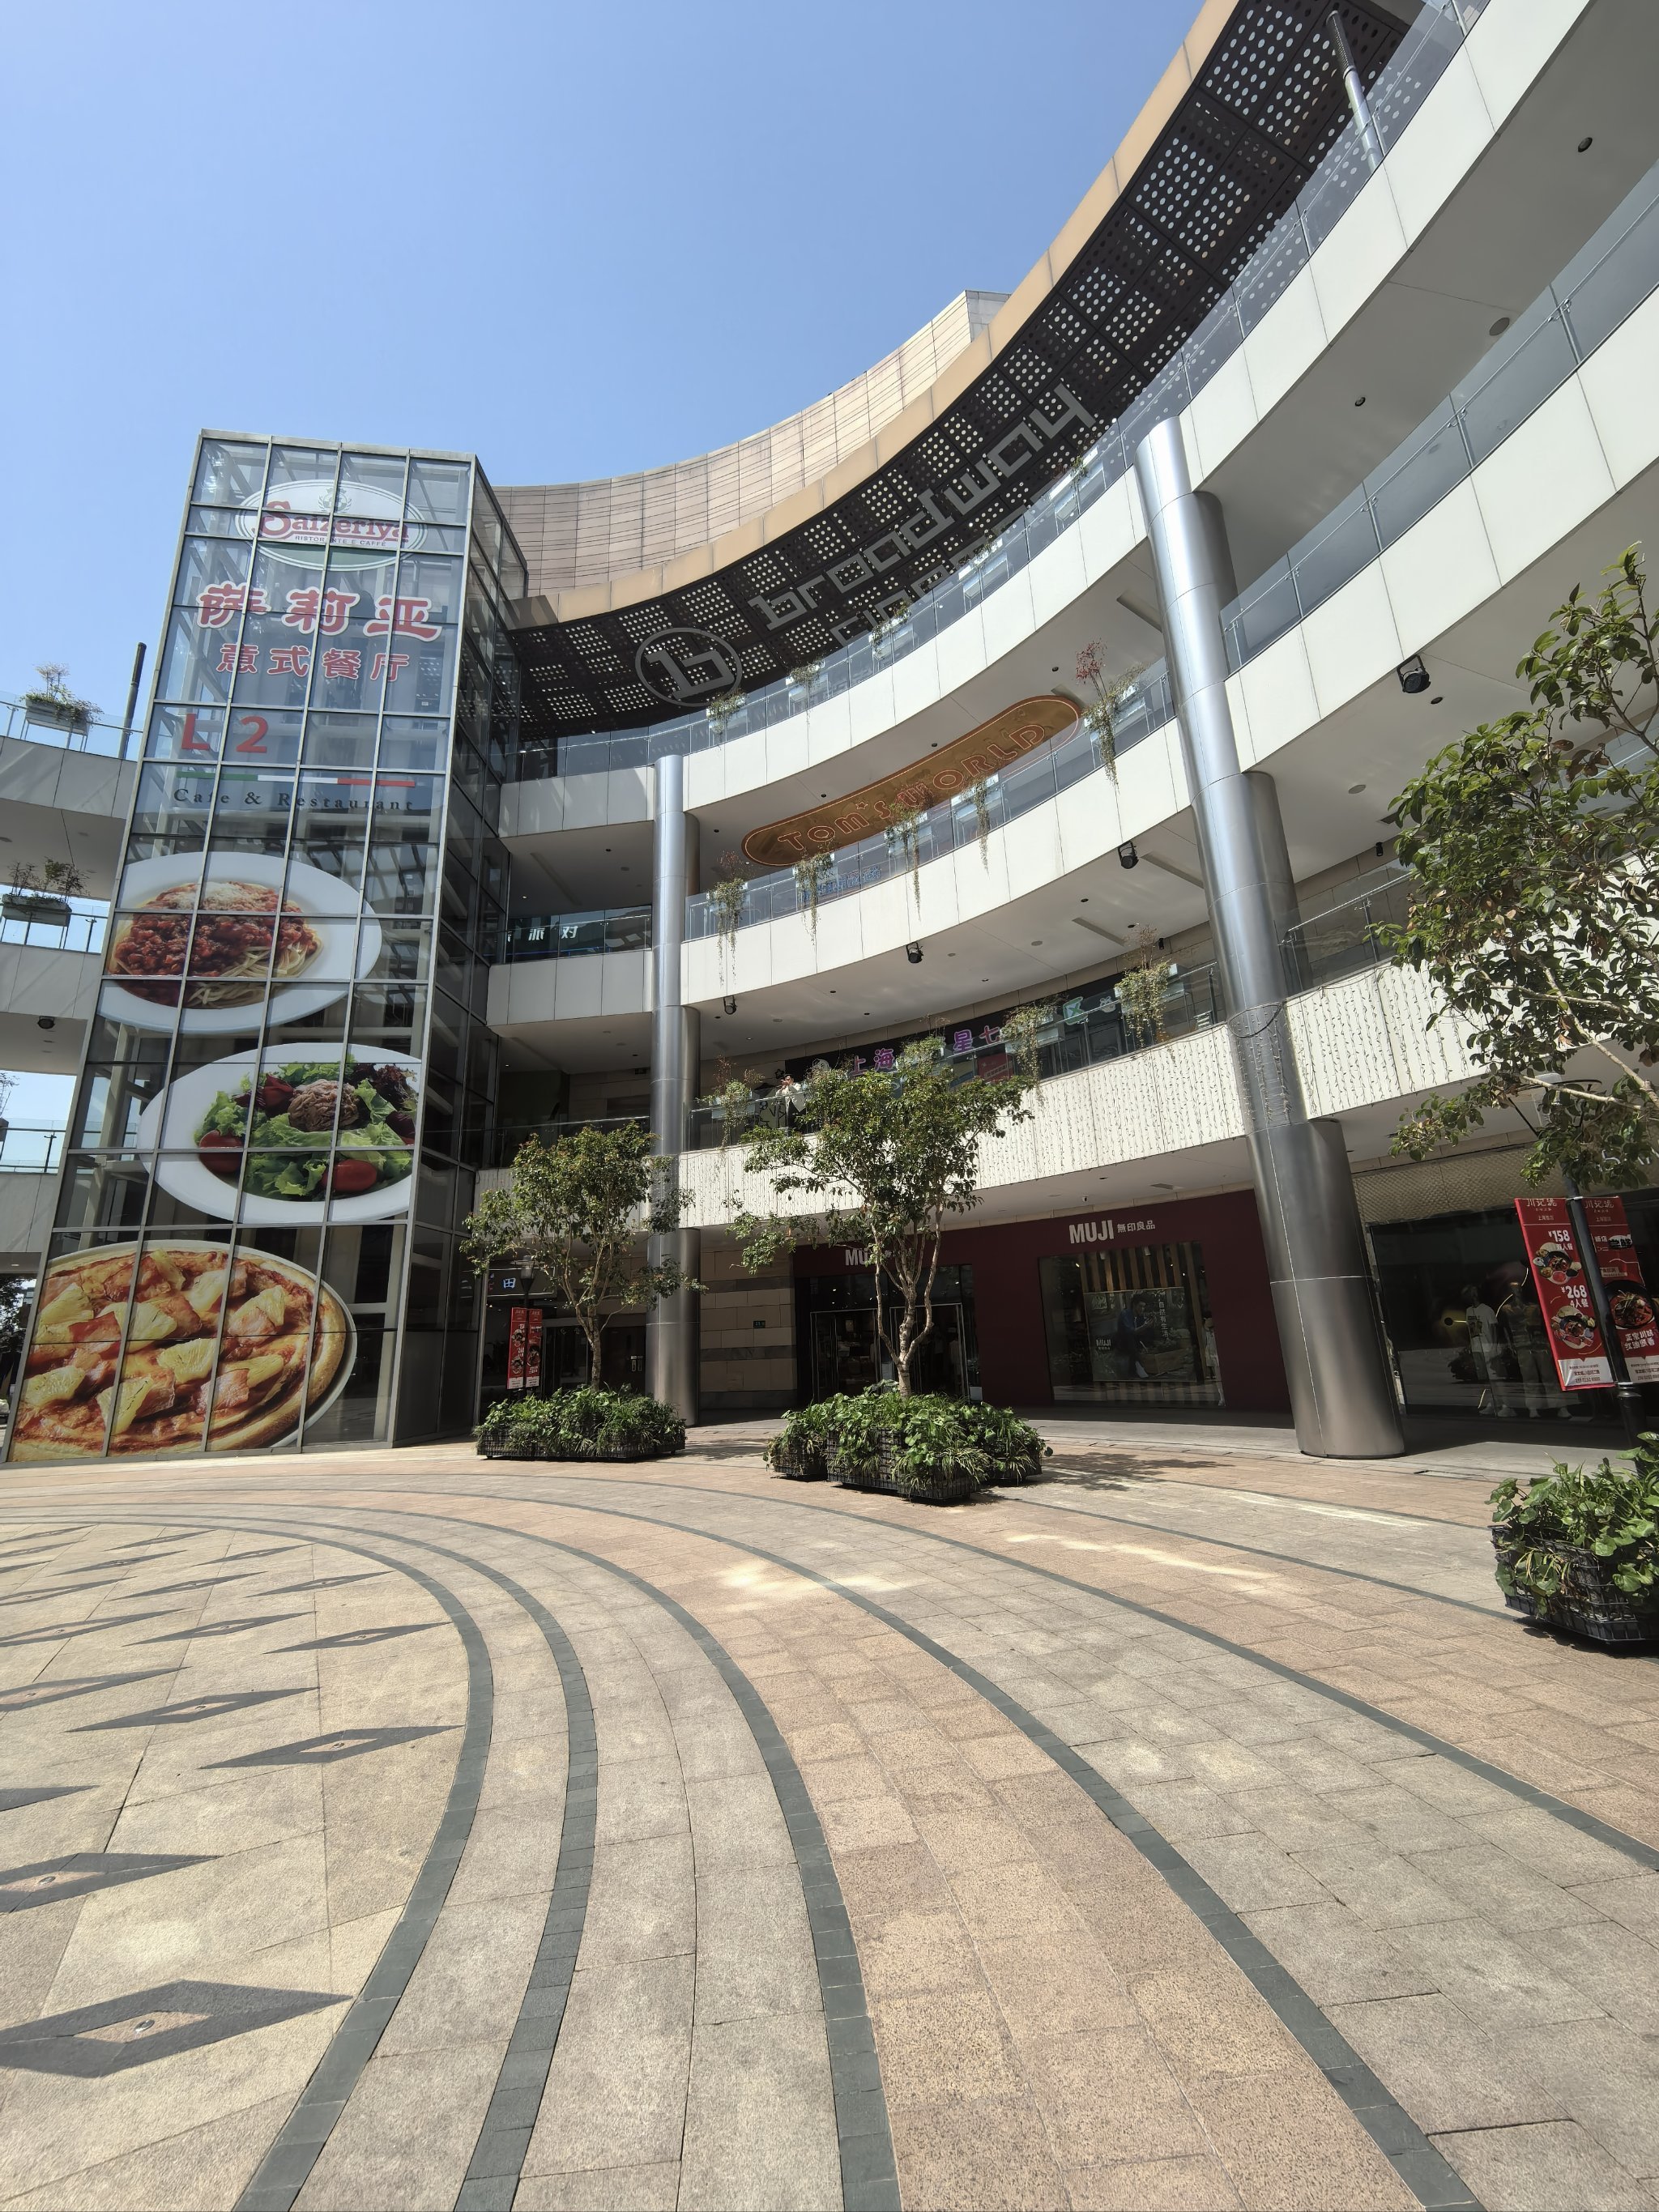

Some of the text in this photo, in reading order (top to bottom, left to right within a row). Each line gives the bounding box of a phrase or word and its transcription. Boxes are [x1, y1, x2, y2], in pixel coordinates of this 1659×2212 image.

[748, 383, 1096, 631] broadway
[254, 501, 409, 539] Saizeriya
[295, 535, 348, 544] RISTORNTE
[197, 581, 443, 642] 萨莉亚
[215, 642, 409, 682] 意式餐厅
[244, 791, 262, 805] &
[507, 926, 578, 943] 派对
[1068, 1219, 1156, 1244] MUJI 無印良品
[1560, 1285, 1588, 1299] ¥268
